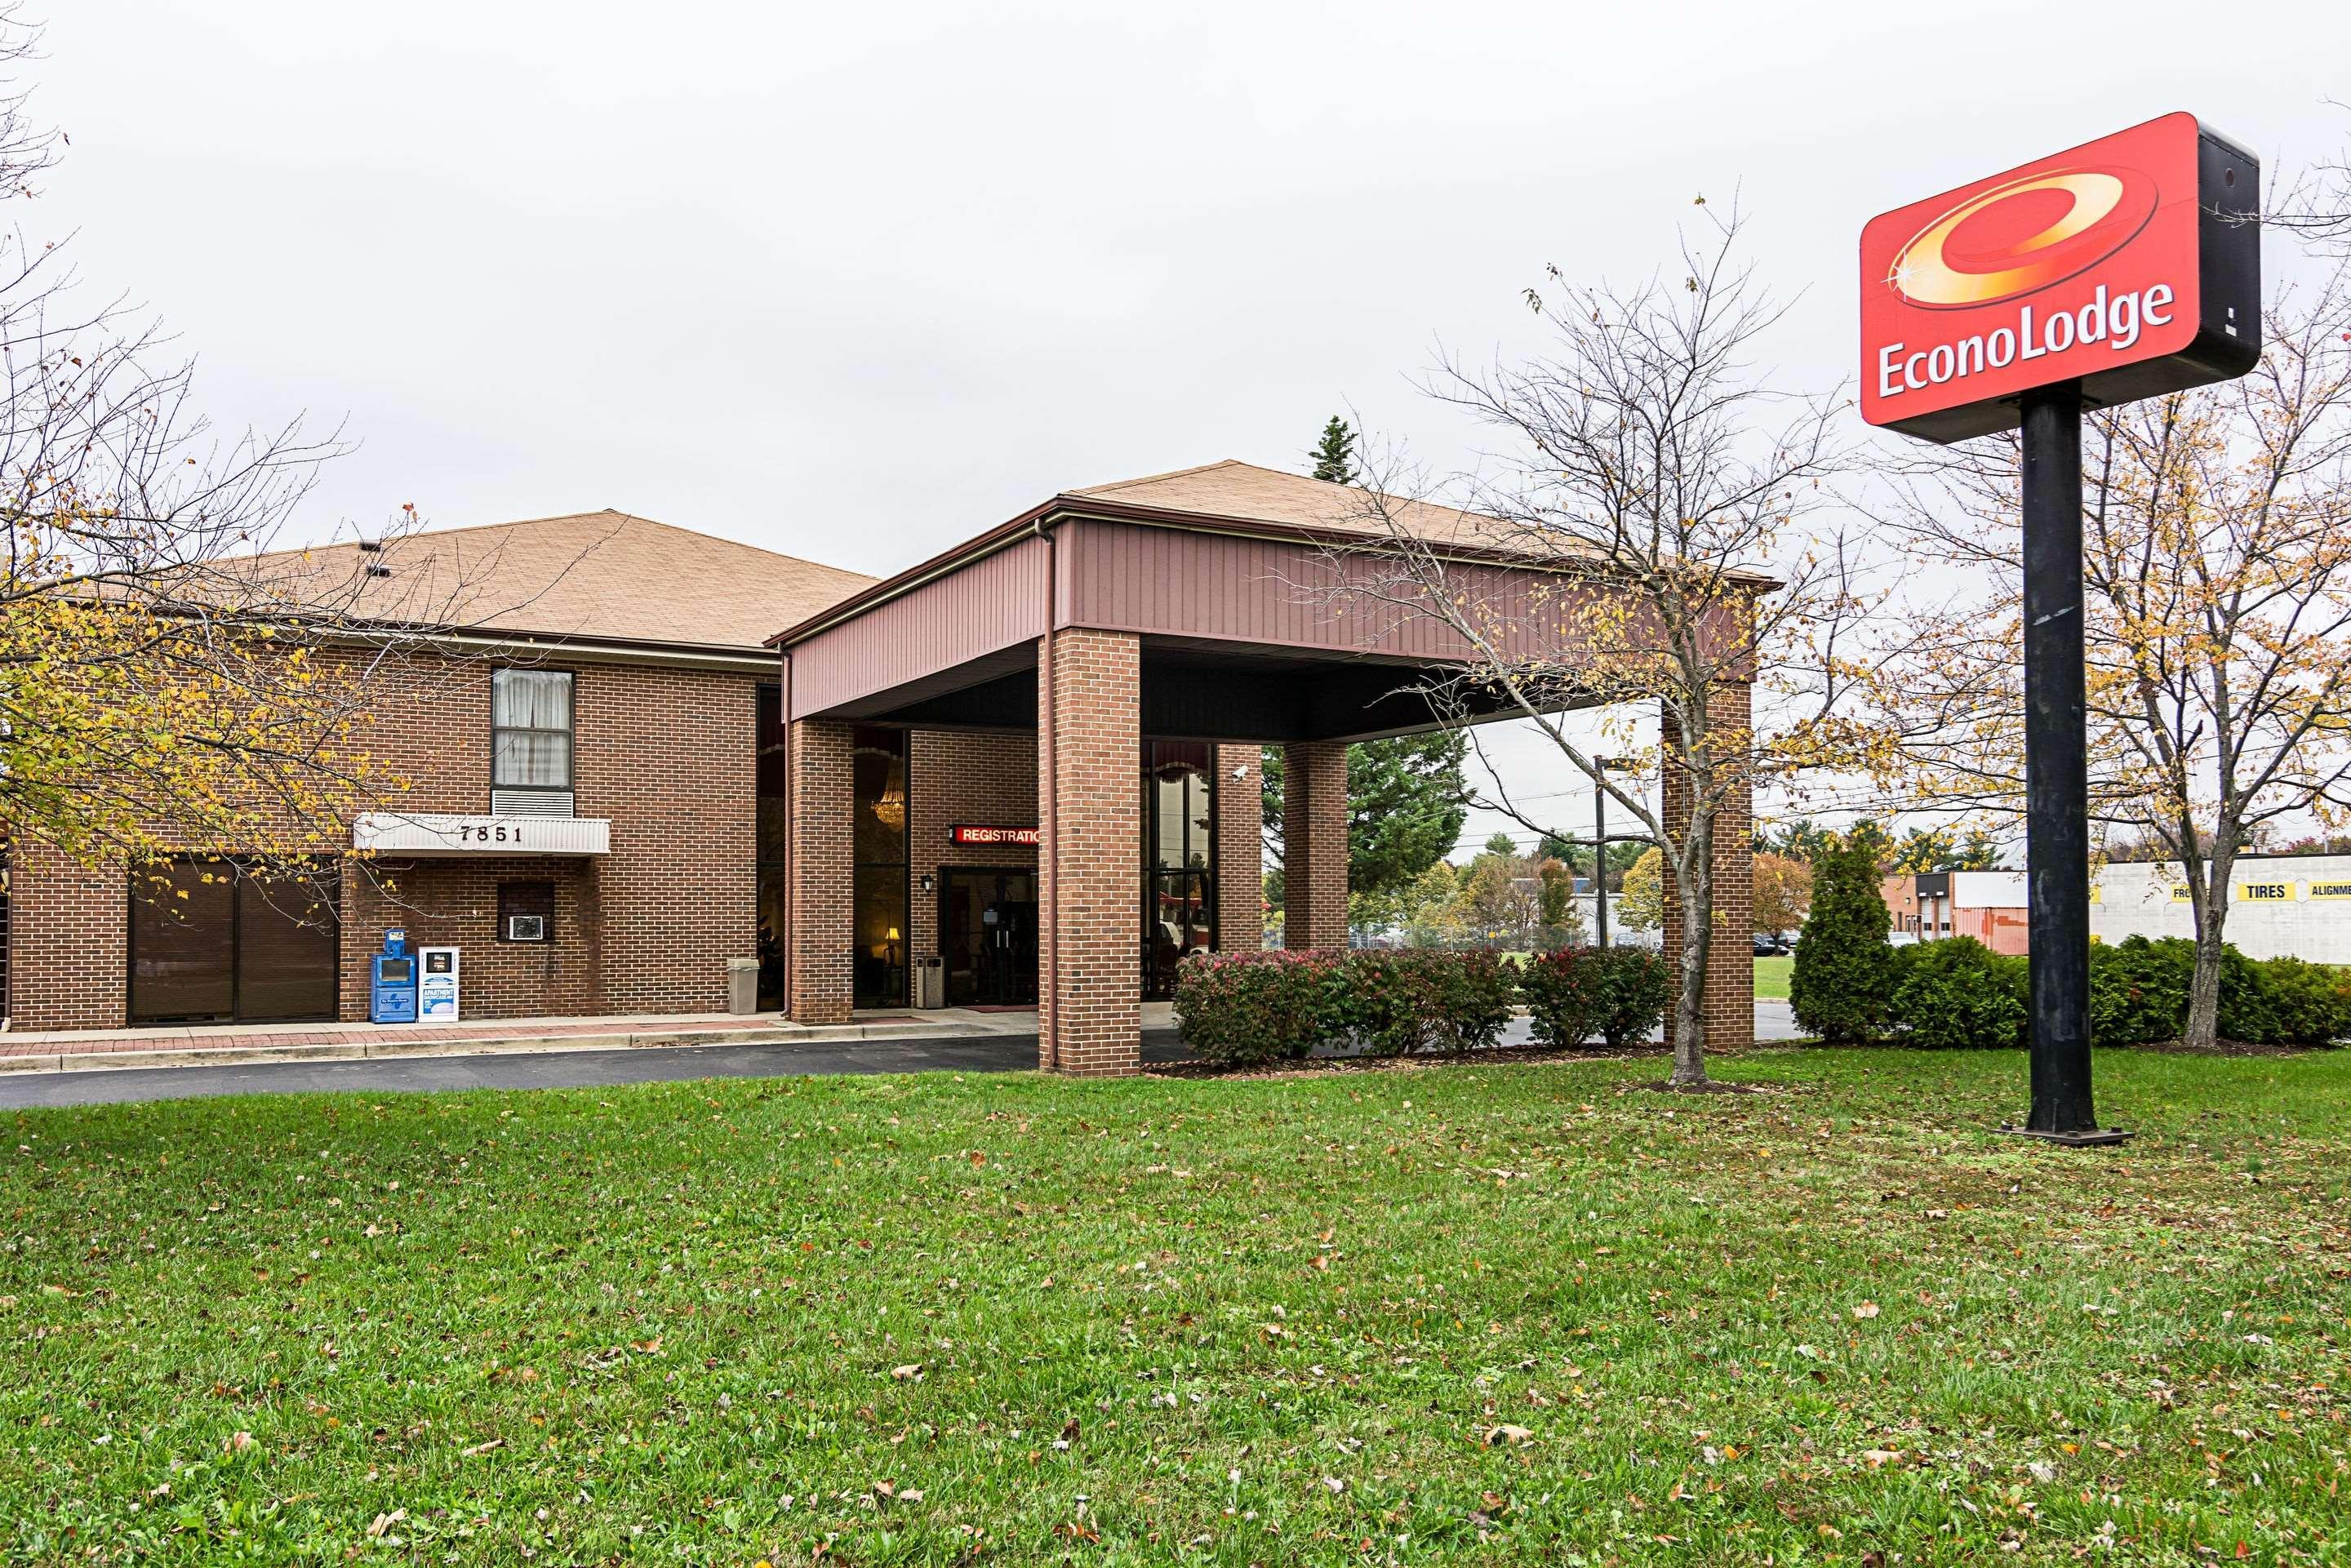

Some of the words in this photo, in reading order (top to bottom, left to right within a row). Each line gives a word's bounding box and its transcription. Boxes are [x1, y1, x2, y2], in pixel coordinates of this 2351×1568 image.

[1879, 283, 2175, 398] EconoLodge
[460, 825, 522, 842] 7851
[962, 828, 1040, 842] REGISTRATIO
[2246, 884, 2286, 899] TIRES
